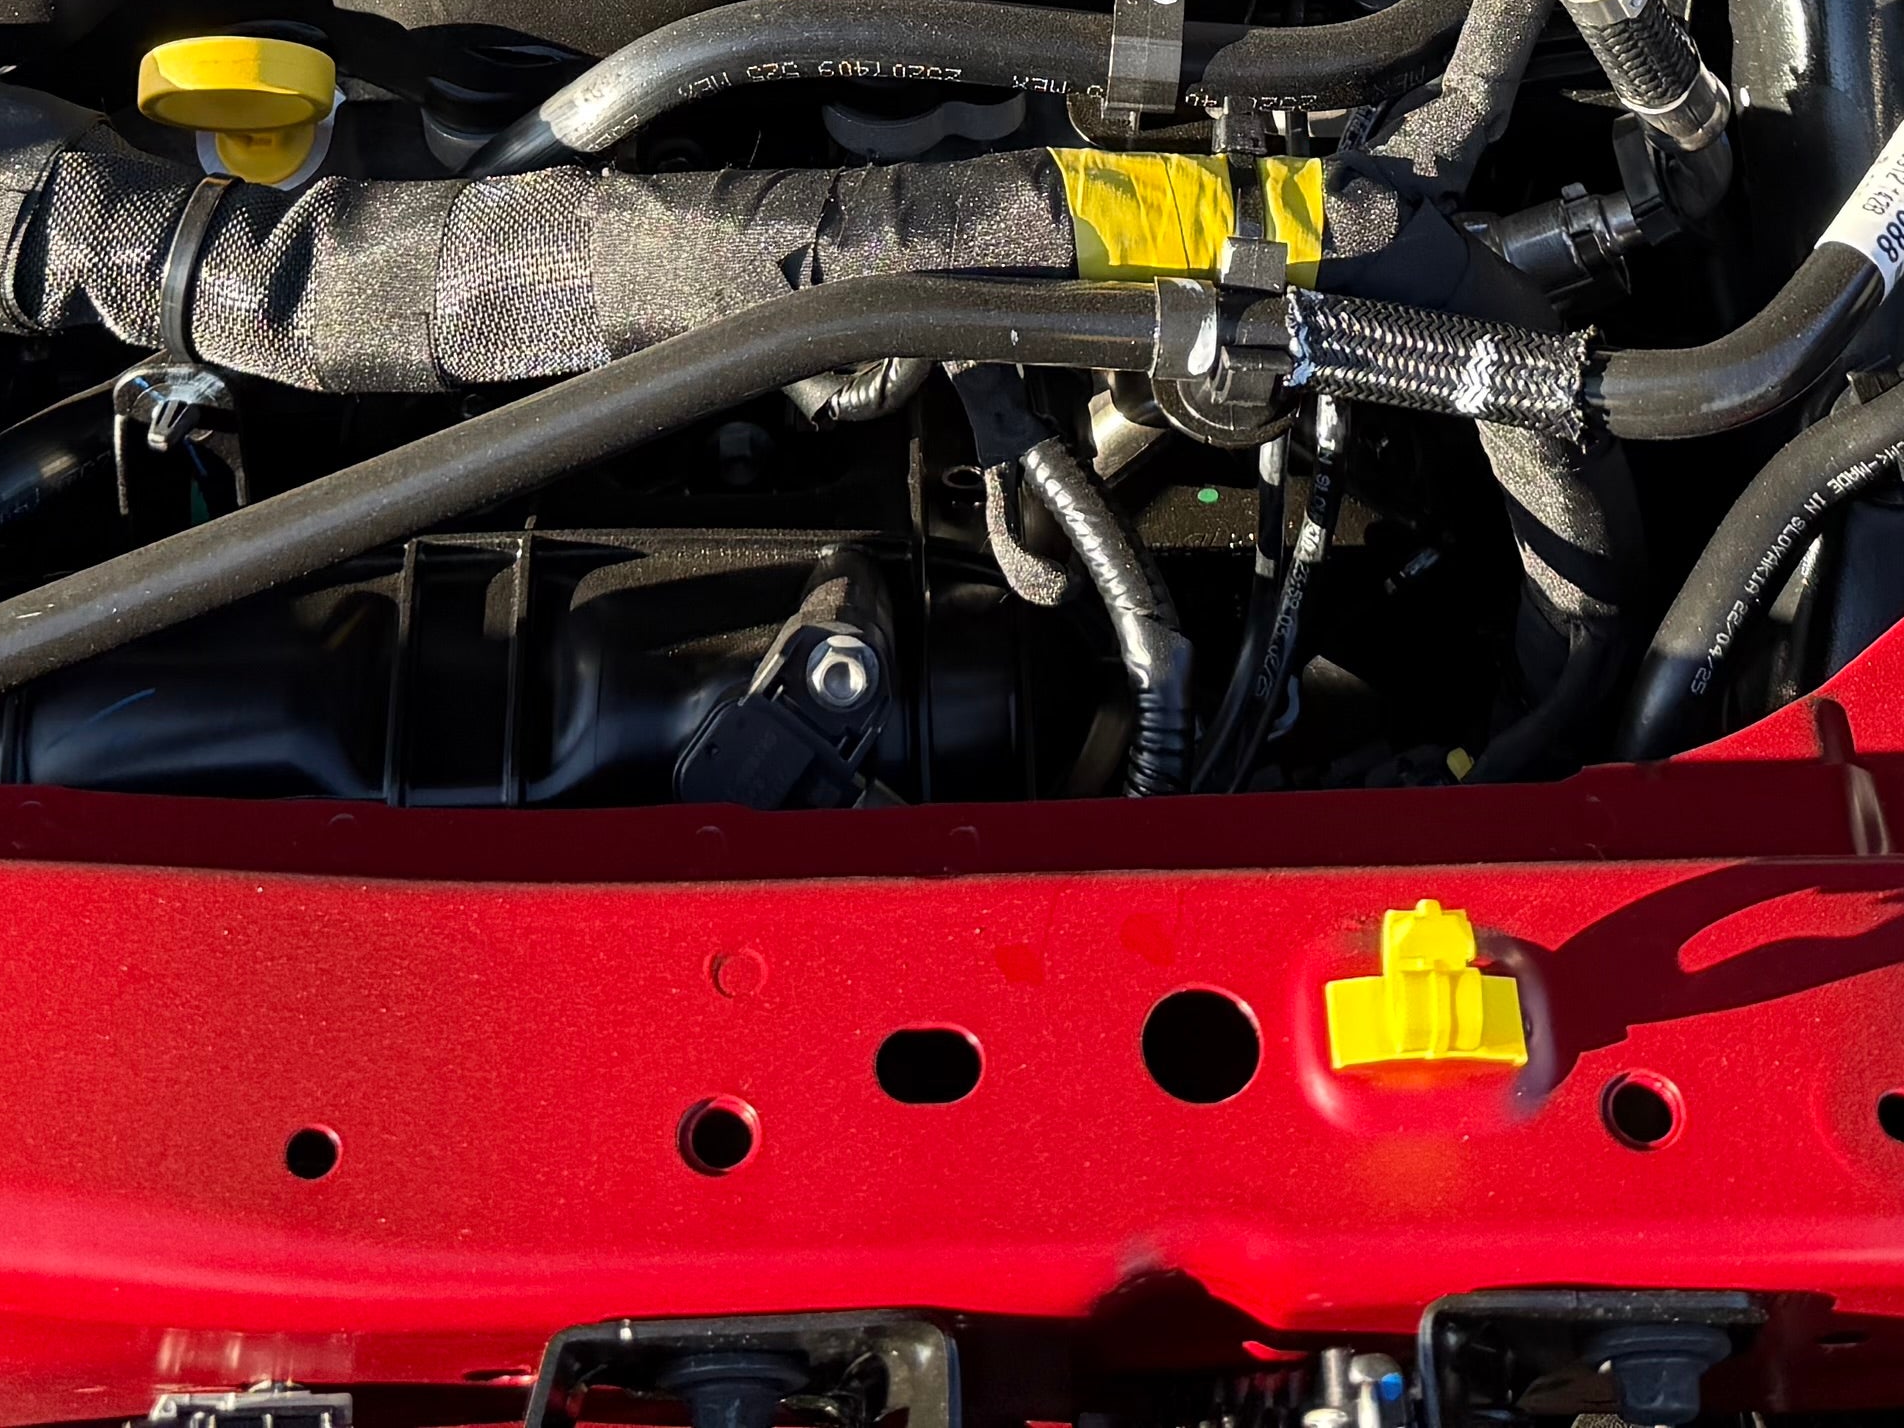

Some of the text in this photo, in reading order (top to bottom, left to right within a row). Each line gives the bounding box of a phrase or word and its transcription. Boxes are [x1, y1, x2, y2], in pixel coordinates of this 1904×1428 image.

[1803, 490, 1827, 520] IN
[1742, 515, 1807, 601] SLOVAKIA
[1689, 598, 1753, 697] 22/04/25
